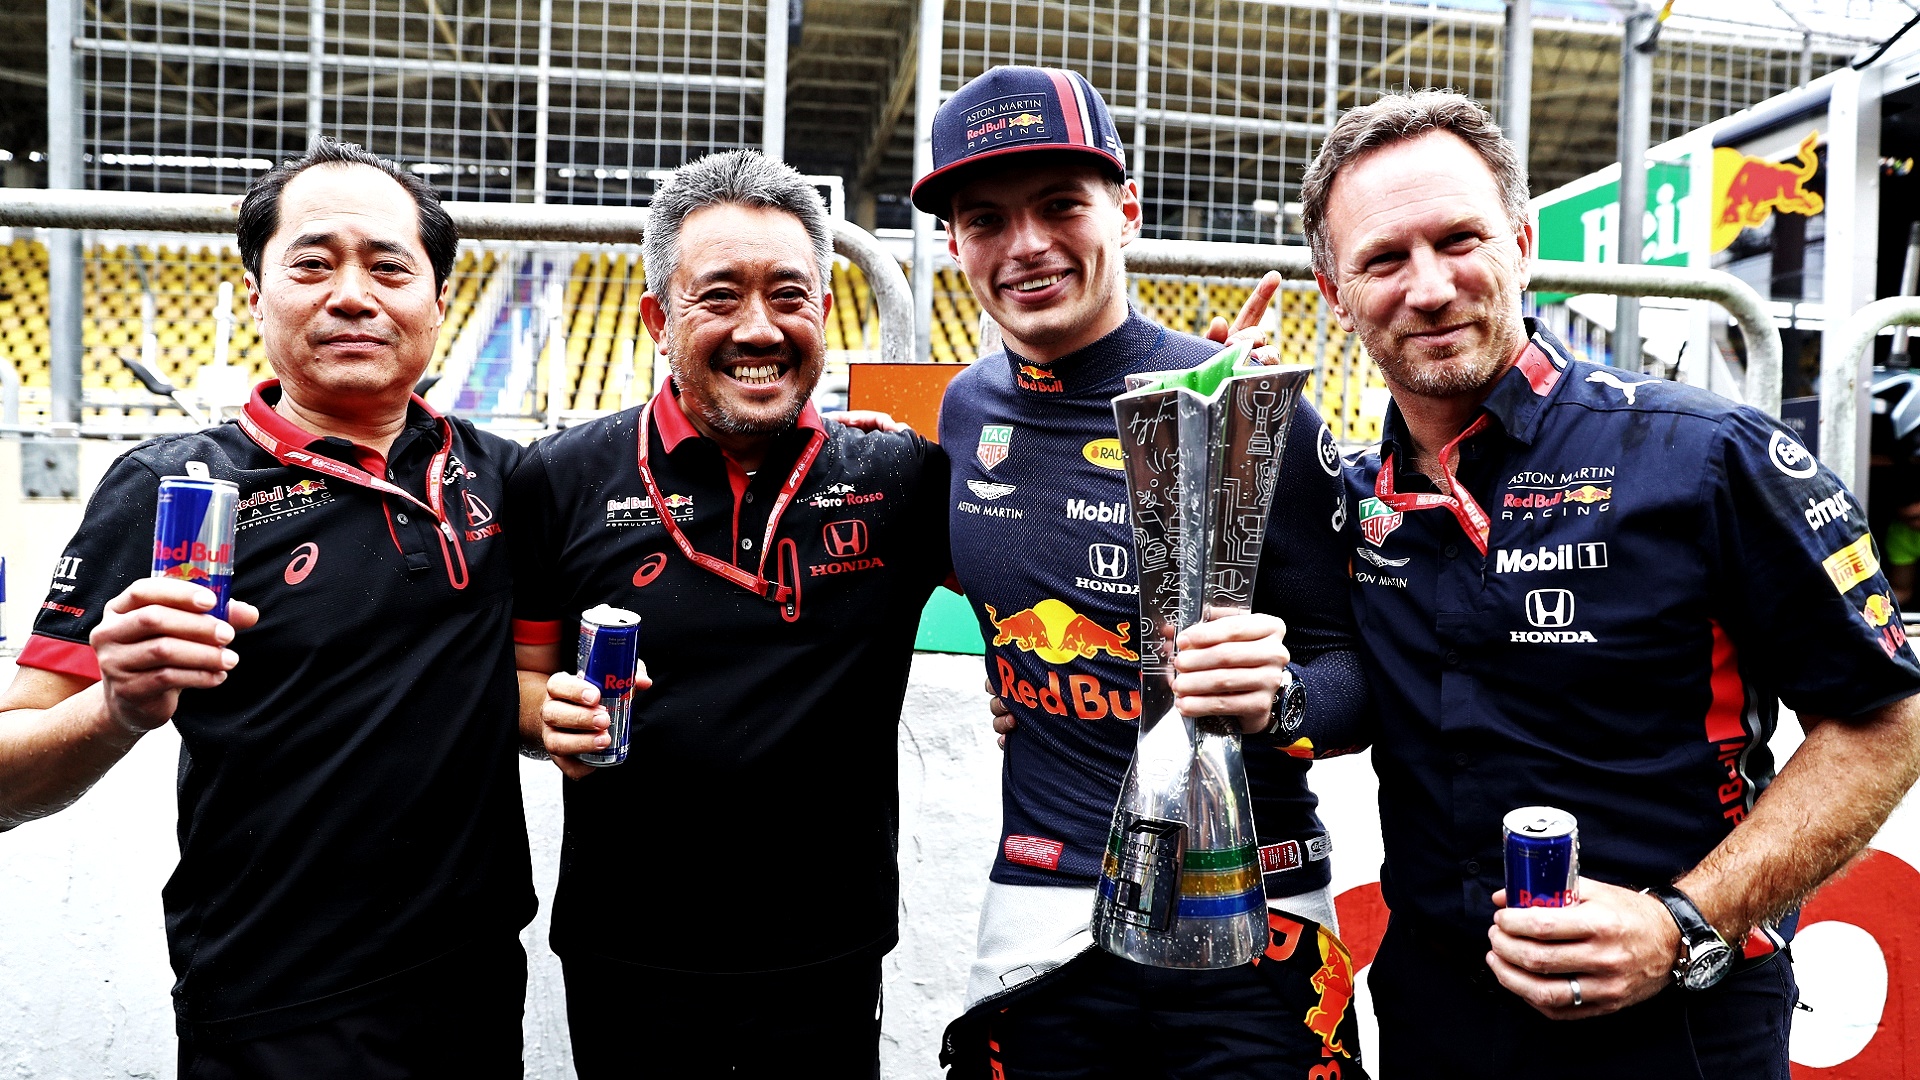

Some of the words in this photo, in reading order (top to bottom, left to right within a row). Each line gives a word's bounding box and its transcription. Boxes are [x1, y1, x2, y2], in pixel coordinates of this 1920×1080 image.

[966, 106, 995, 124] ASTON
[1000, 99, 1042, 113] MARTIN
[967, 121, 986, 140] Red
[986, 117, 1006, 133] Bull
[967, 126, 1045, 149] RACING
[1017, 375, 1038, 391] Red
[1037, 380, 1063, 392] Bull
[983, 427, 1008, 443] TAG
[979, 444, 1007, 467] HEUER
[1100, 446, 1123, 460] RAU
[1508, 472, 1554, 485] ASTON
[1560, 466, 1615, 484] MARTIN
[257, 486, 284, 504] Bull
[607, 497, 630, 511] Red
[846, 492, 884, 505] Rosso
[1503, 493, 1534, 508] Red
[1534, 491, 1563, 509] Bull
[239, 492, 331, 521] ACING
[607, 507, 694, 519] RACNG
[957, 500, 980, 514] ASTON
[983, 506, 1024, 519] MARTIN
[1066, 498, 1126, 525] Mobil
[1361, 500, 1389, 517] TA
[1502, 502, 1610, 520] RACING
[1362, 514, 1401, 543] HEUER
[191, 541, 231, 564] Bull
[1496, 544, 1573, 573] Mobil
[809, 558, 884, 577] HONDA
[1075, 577, 1140, 596] HONDA
[1510, 631, 1598, 643] HONDA
[996, 654, 1068, 717] Red
[1069, 674, 1142, 720] Bu
